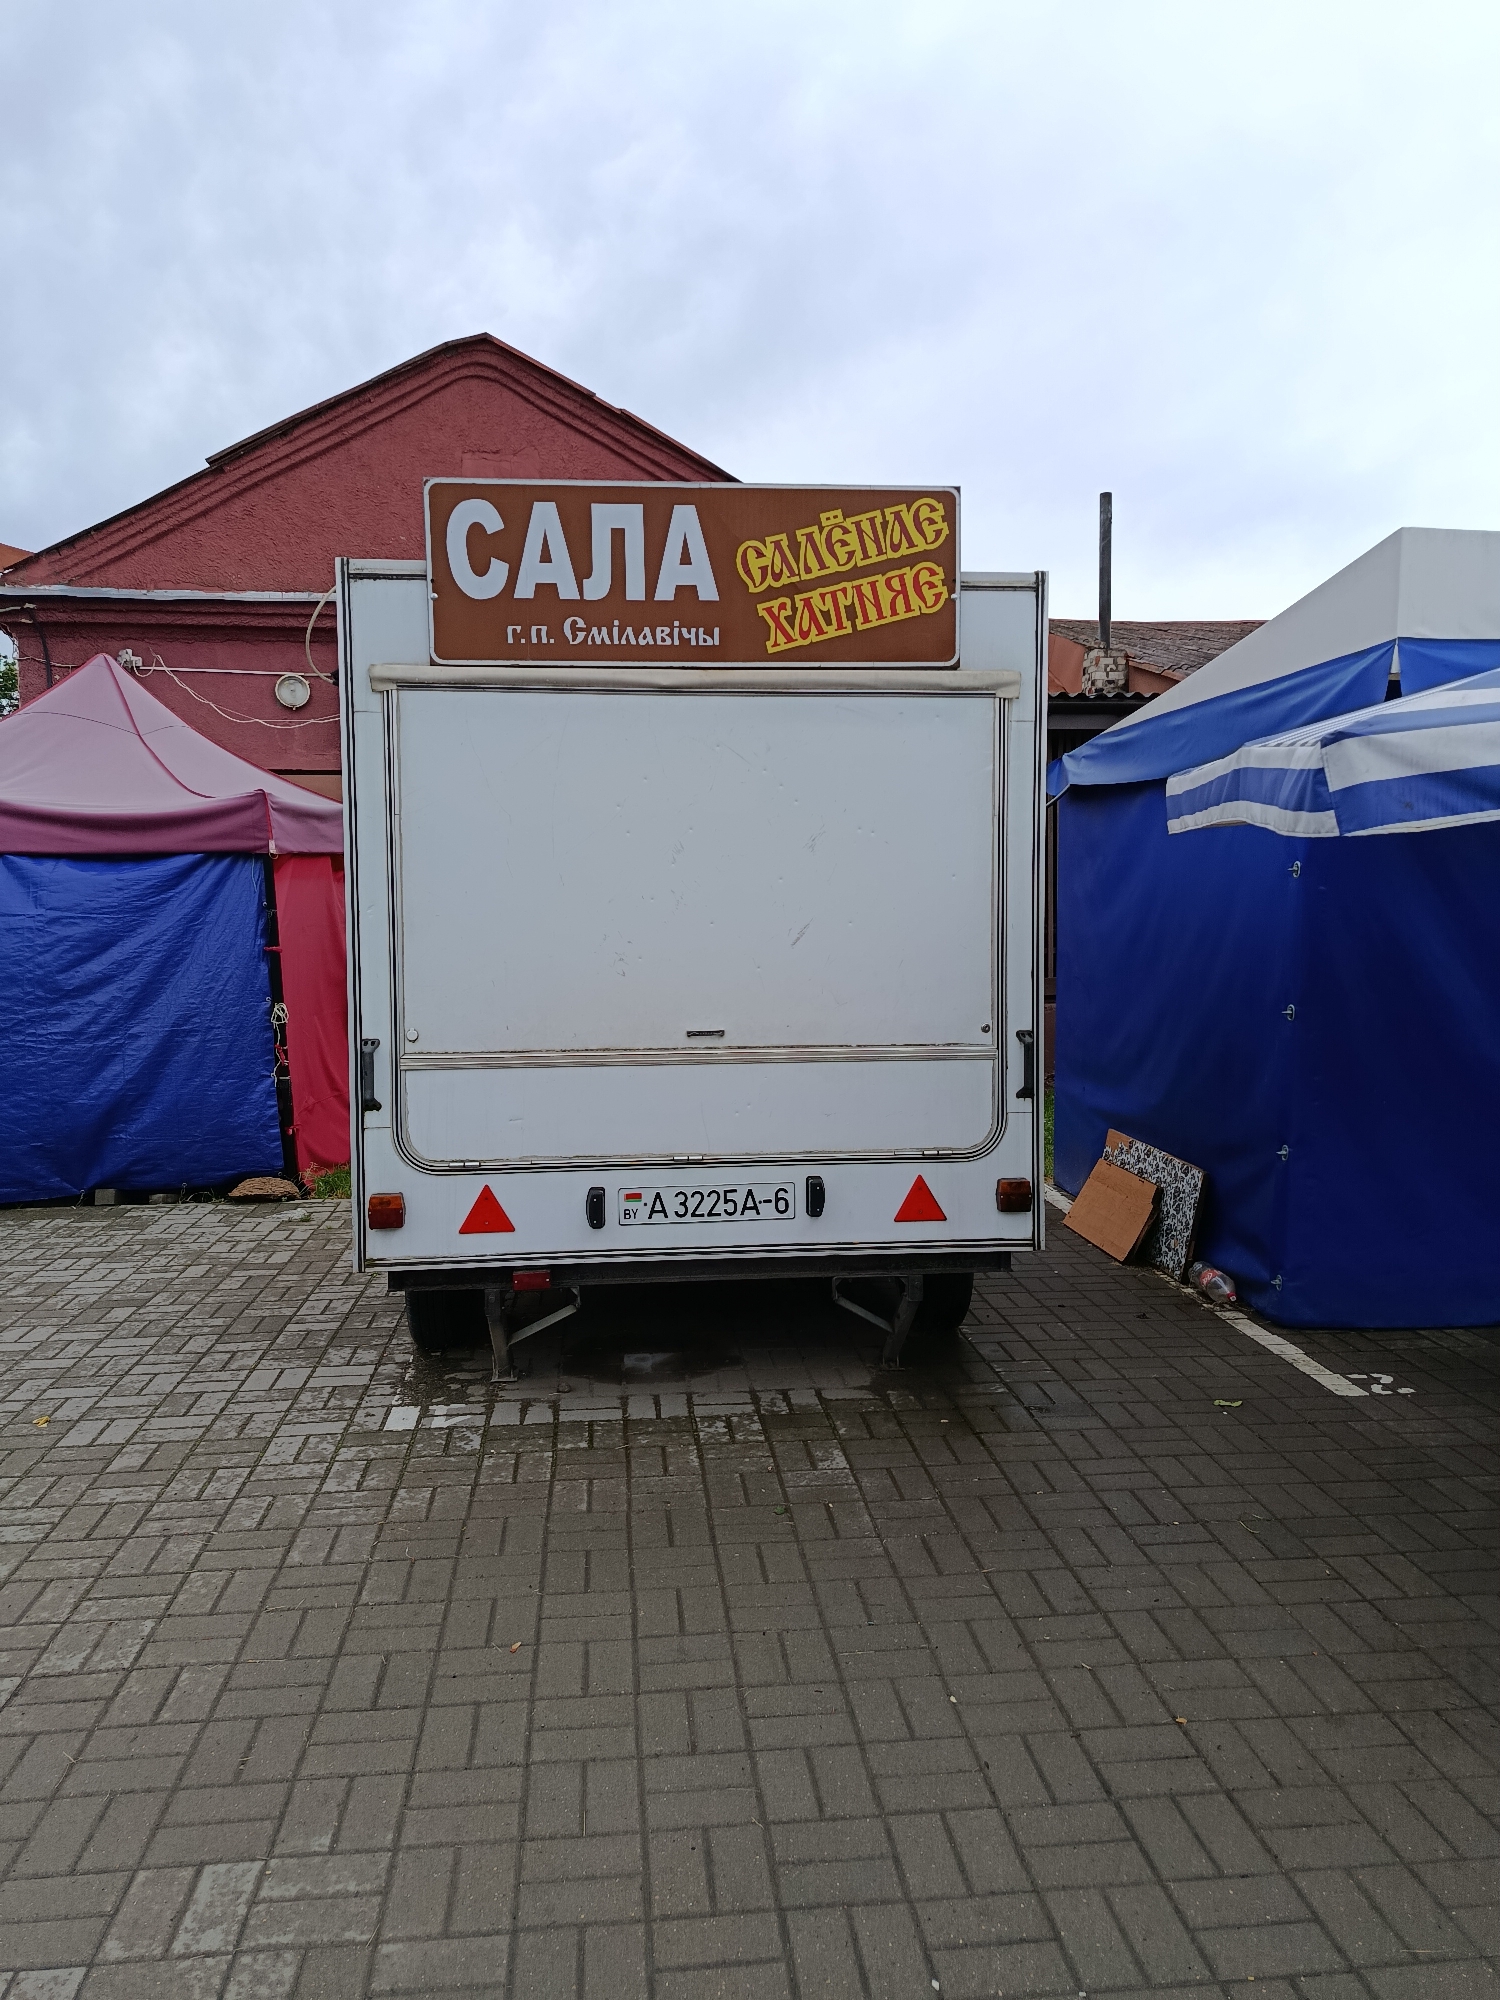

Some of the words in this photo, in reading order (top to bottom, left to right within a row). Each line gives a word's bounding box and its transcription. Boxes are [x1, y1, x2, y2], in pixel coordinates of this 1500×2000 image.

[445, 498, 720, 601] САЛА
[506, 625, 555, 644] г.п.
[563, 616, 720, 646] Смілавічы
[623, 1208, 639, 1220] BY
